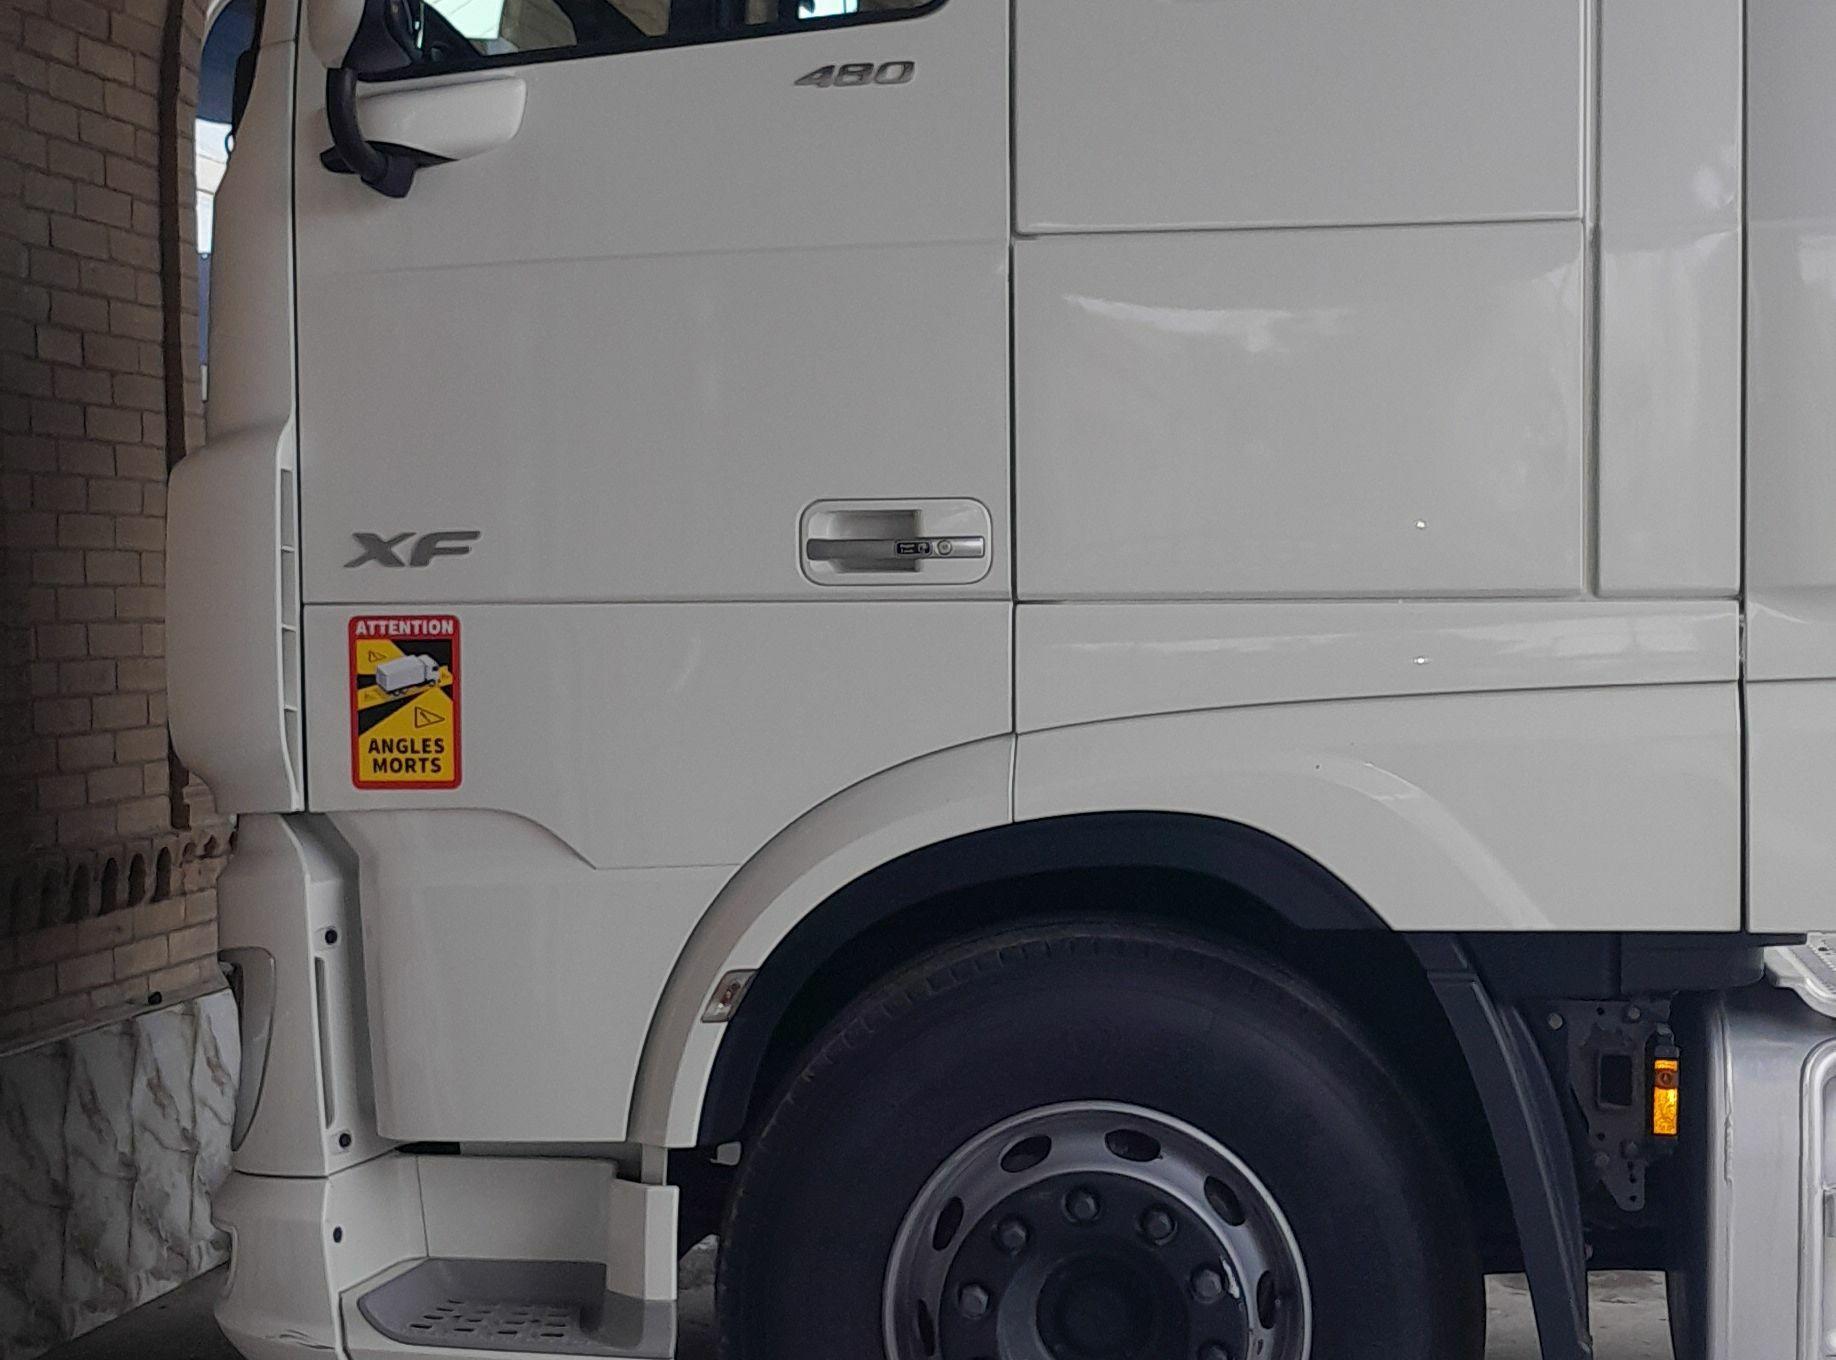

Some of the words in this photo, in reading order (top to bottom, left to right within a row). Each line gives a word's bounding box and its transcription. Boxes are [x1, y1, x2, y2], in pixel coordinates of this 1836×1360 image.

[794, 61, 915, 88] 480
[343, 530, 481, 568] XF
[355, 620, 454, 636] ATTENTION
[368, 738, 445, 755] ANGLES
[372, 757, 442, 774] MORTS
